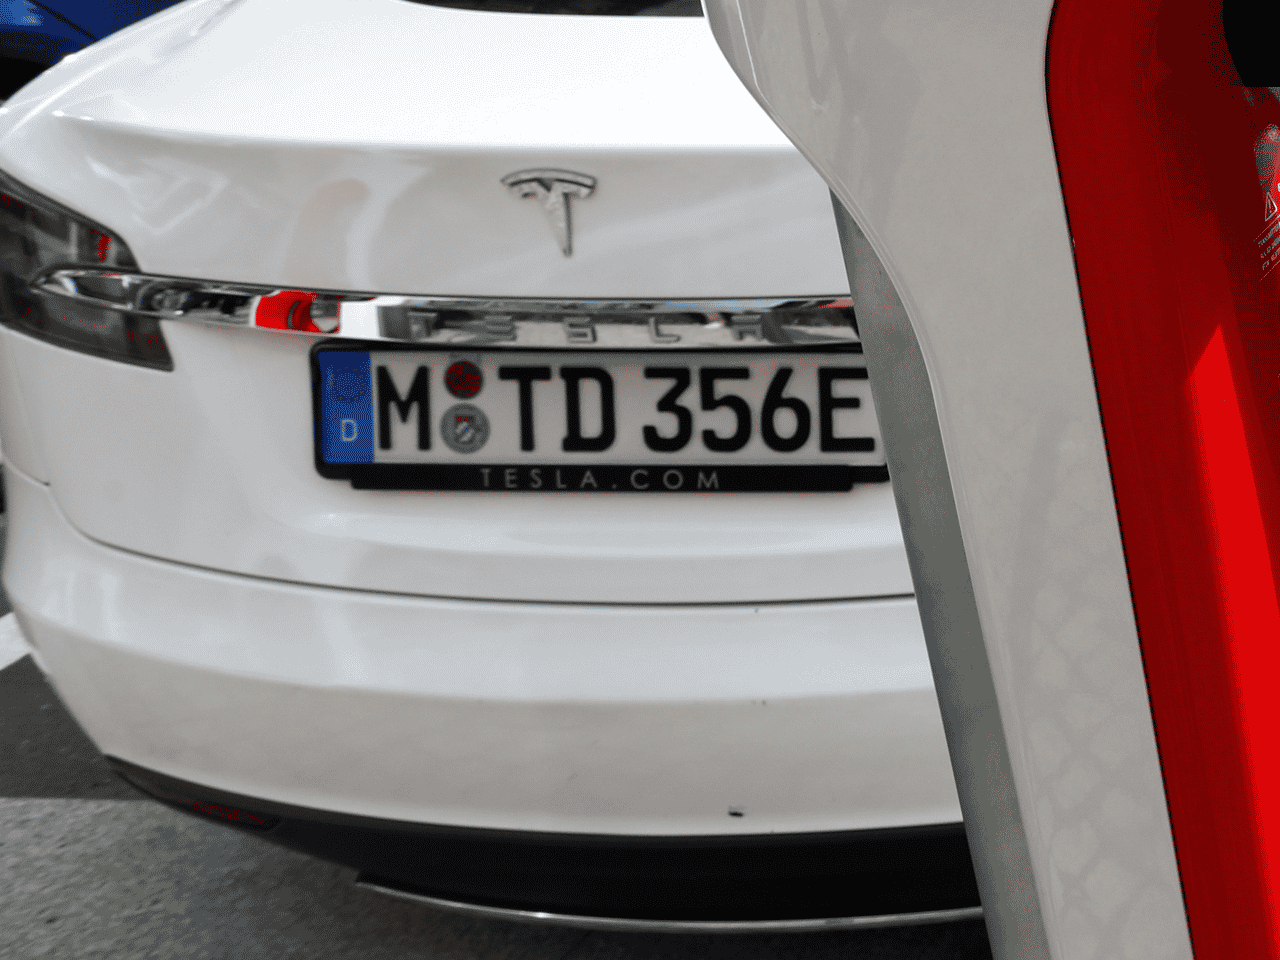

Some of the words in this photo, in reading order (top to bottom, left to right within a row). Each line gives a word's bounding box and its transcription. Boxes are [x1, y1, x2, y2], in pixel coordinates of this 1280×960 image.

[408, 311, 766, 344] TESLA
[376, 363, 432, 452] M
[497, 364, 617, 453] TD
[641, 364, 876, 453] 356E
[341, 418, 358, 442] D
[480, 468, 720, 490] TESLA.COM
